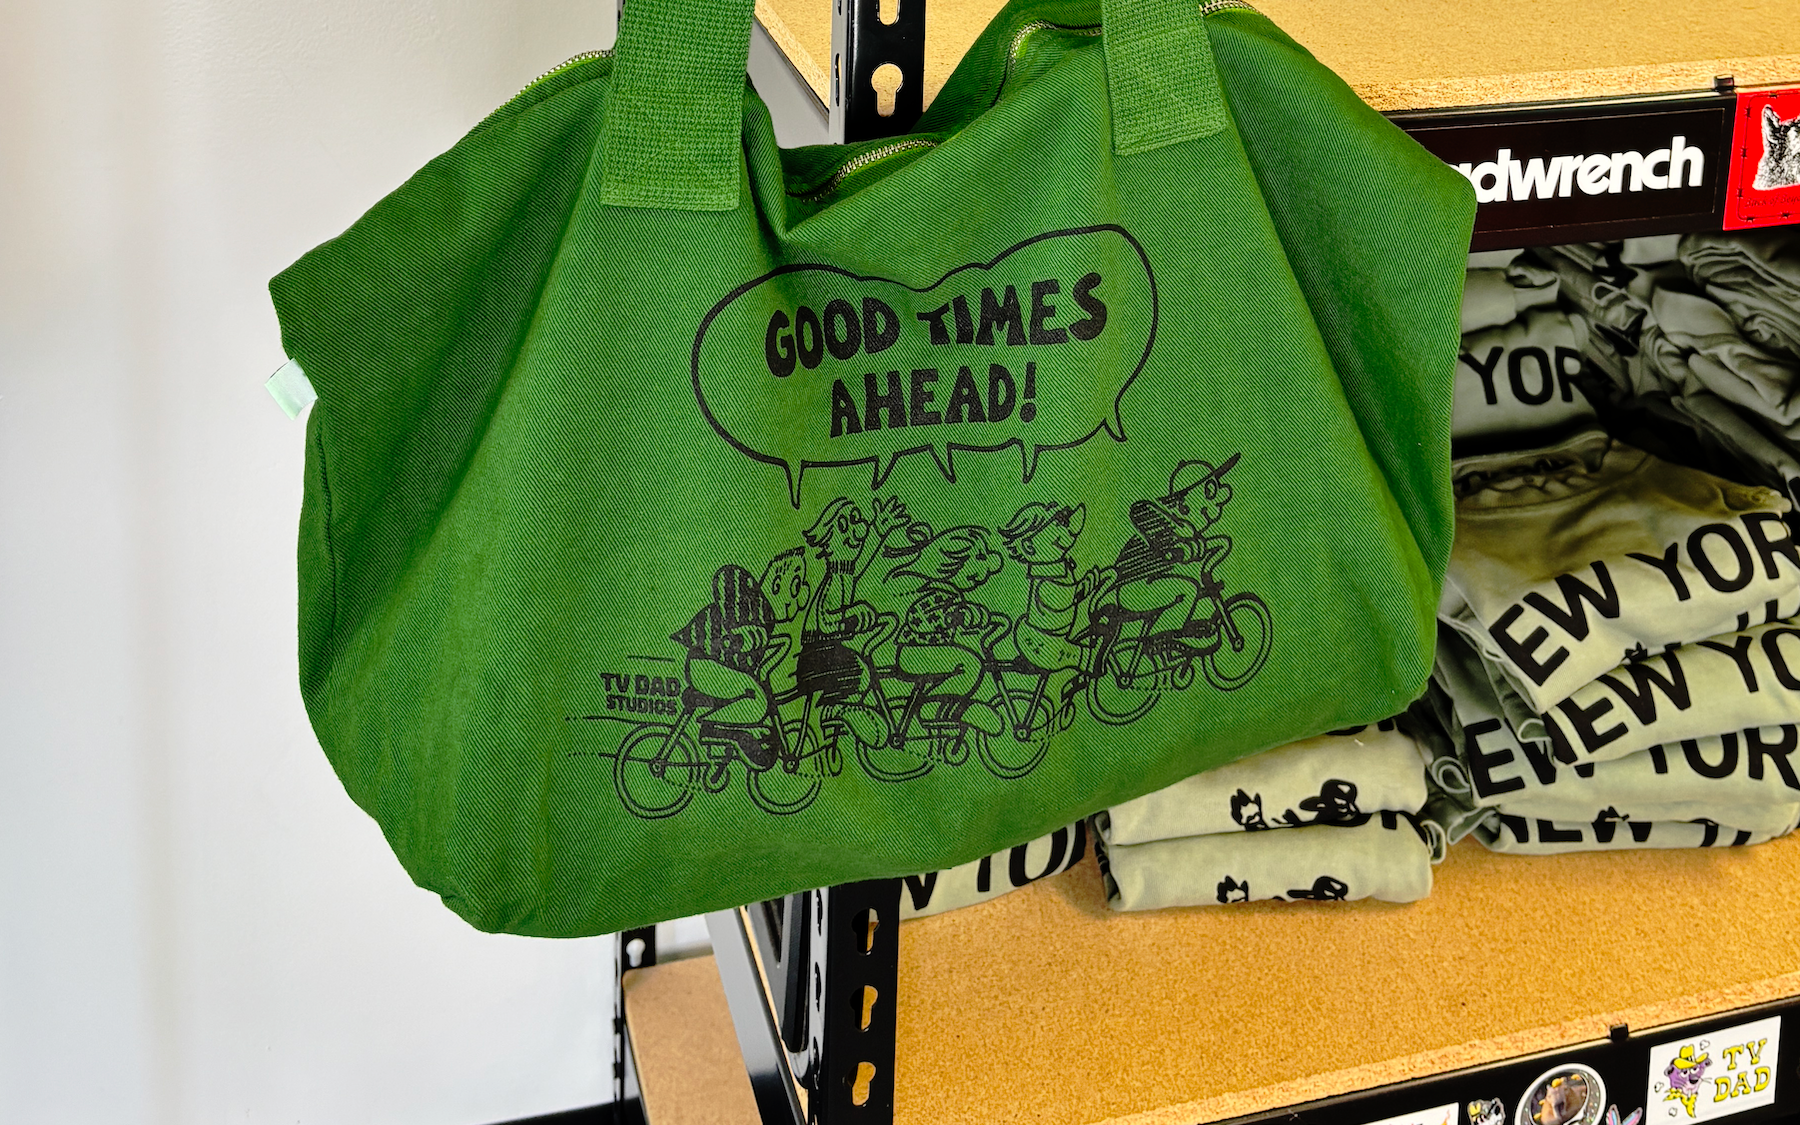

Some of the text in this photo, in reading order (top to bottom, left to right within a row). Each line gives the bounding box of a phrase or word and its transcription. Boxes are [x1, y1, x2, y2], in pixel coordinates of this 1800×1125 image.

[765, 272, 1109, 378] GOOD TIMES
[828, 361, 1038, 439] AHEAD!
[1458, 346, 1590, 405] YOR
[1488, 511, 1800, 687] EW YOR
[599, 673, 681, 696] TV DAD
[1696, 627, 1800, 693] YO
[606, 695, 677, 716] STUDIOS
[1723, 1038, 1767, 1070] TV
[1714, 1066, 1771, 1102] DAD
